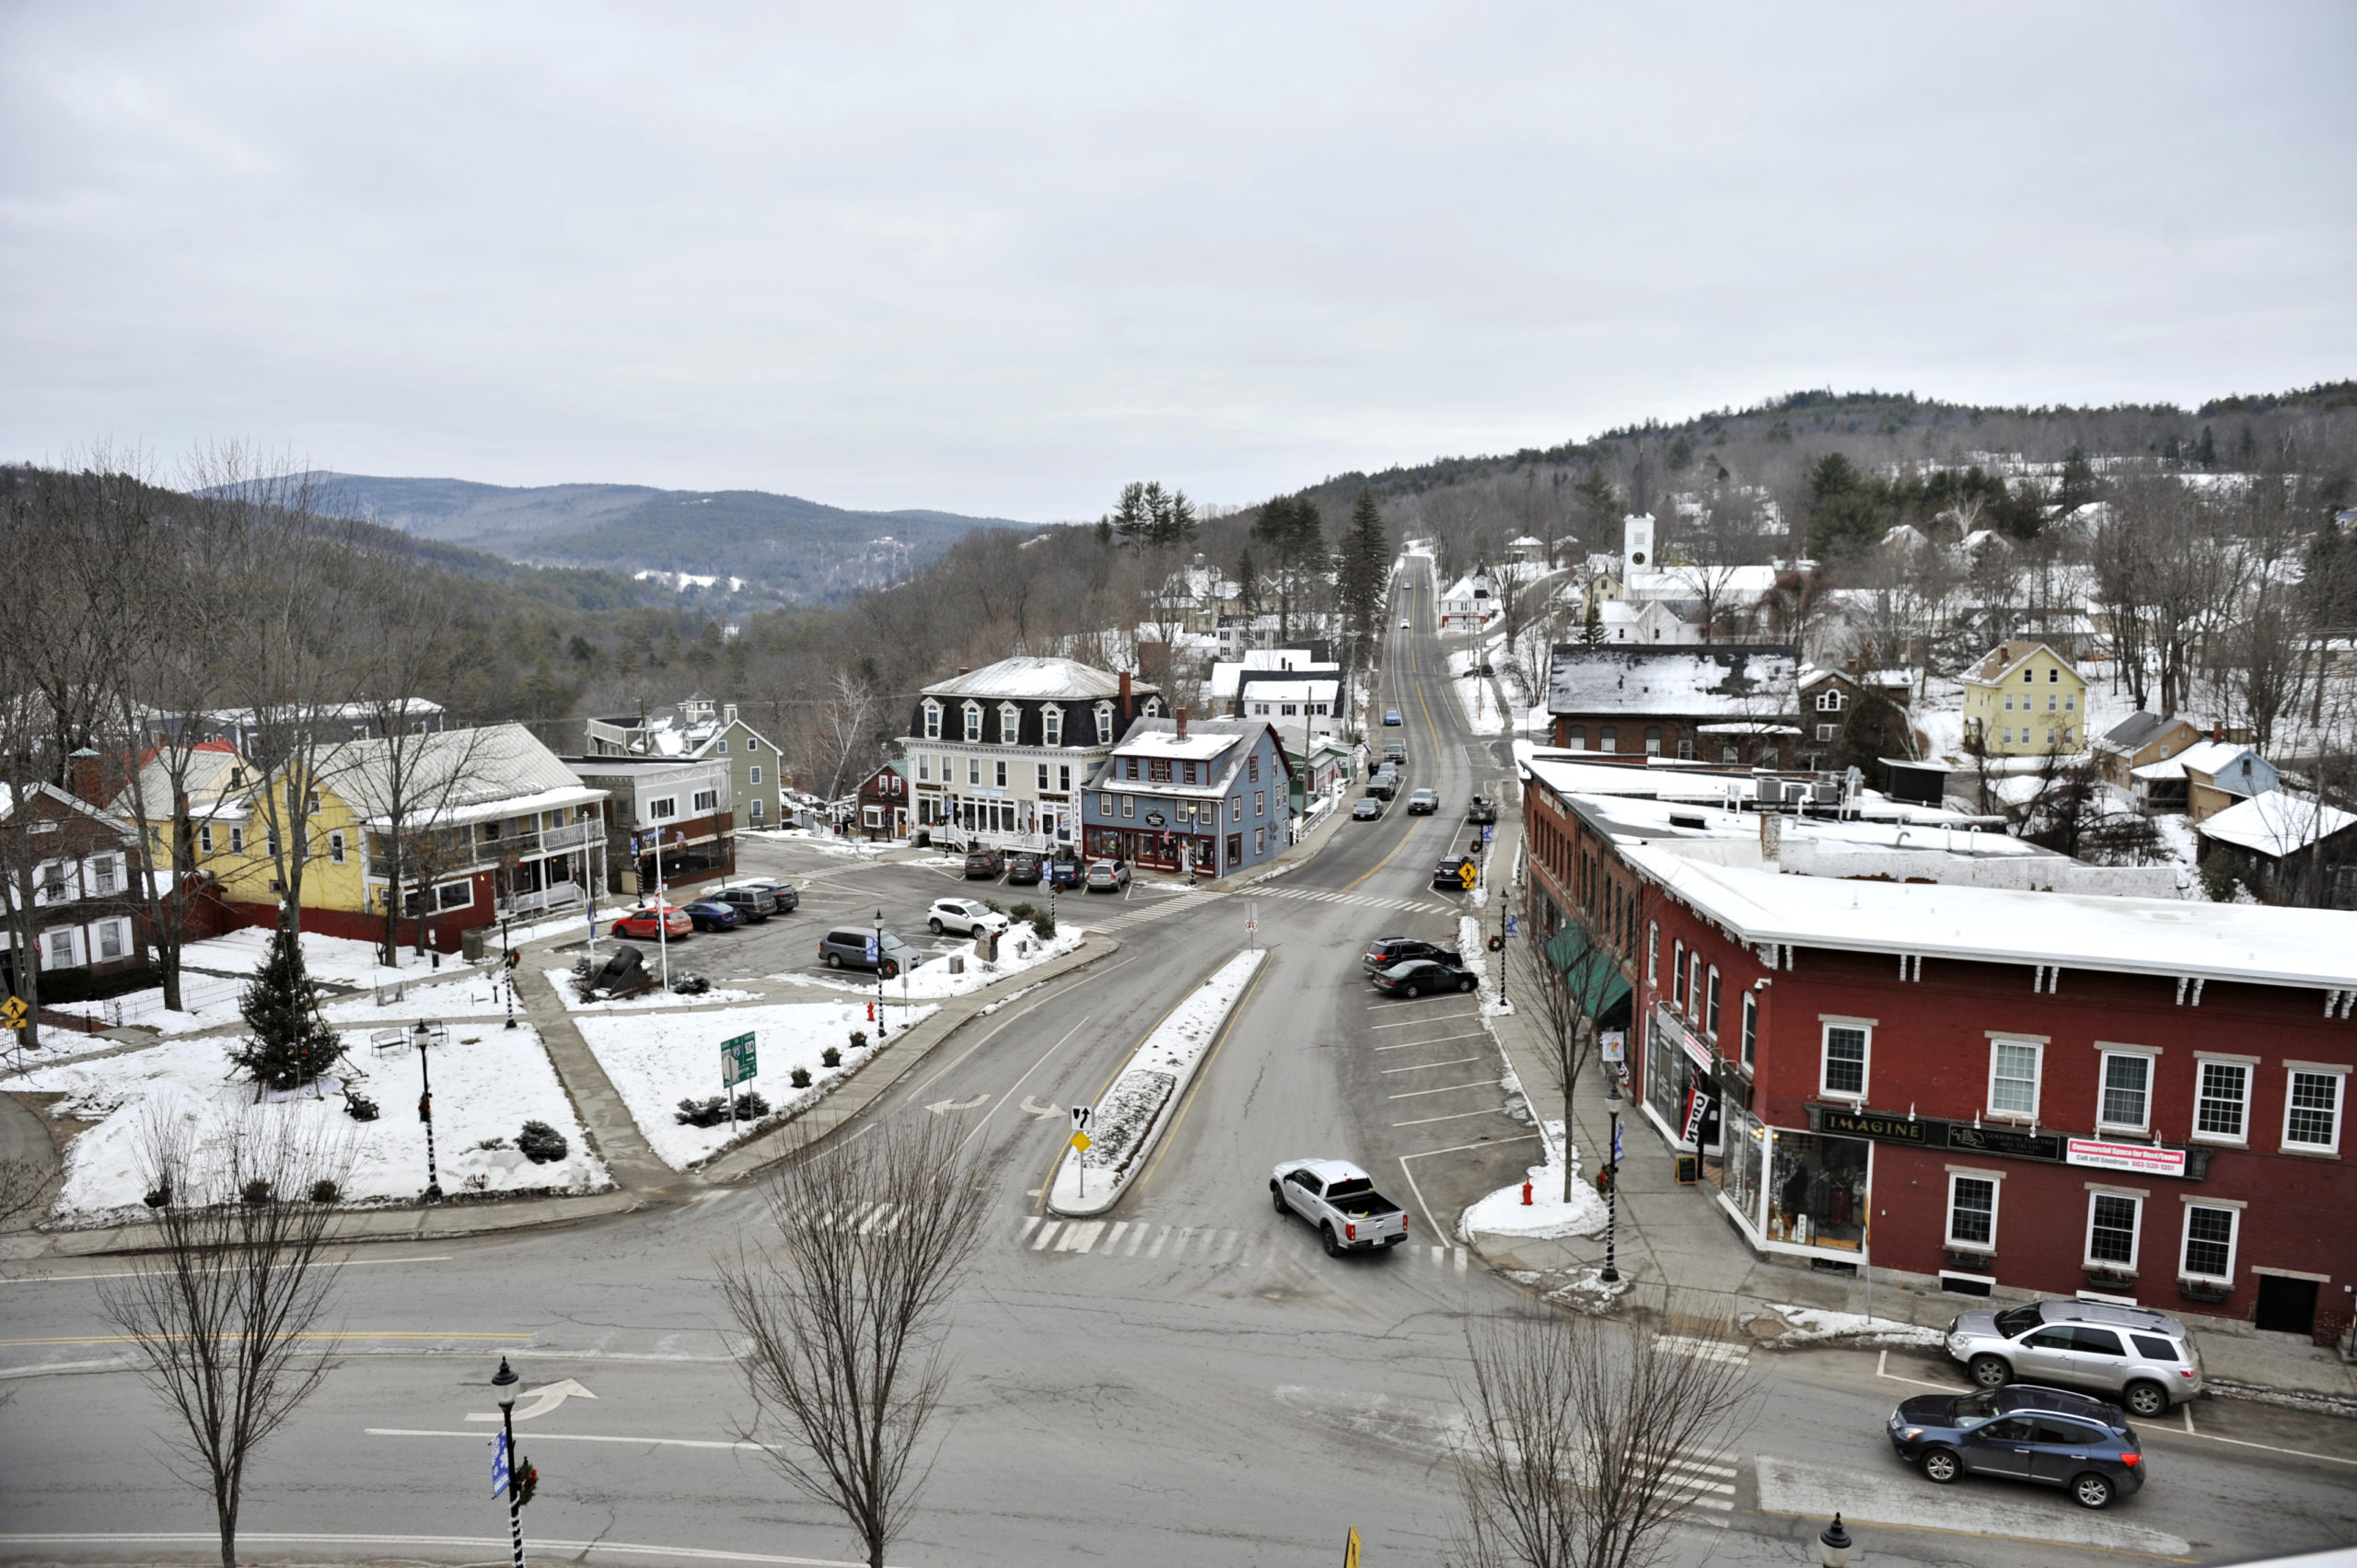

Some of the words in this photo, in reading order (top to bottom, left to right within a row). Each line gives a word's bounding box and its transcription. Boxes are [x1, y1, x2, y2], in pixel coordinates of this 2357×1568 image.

[1829, 1116, 1920, 1137] IMAGINE
[2072, 1143, 2111, 1154] Commercial
[2112, 1147, 2132, 1156] Space
[2132, 1148, 2142, 1157] for
[2100, 1157, 2129, 1166] Goodrum
